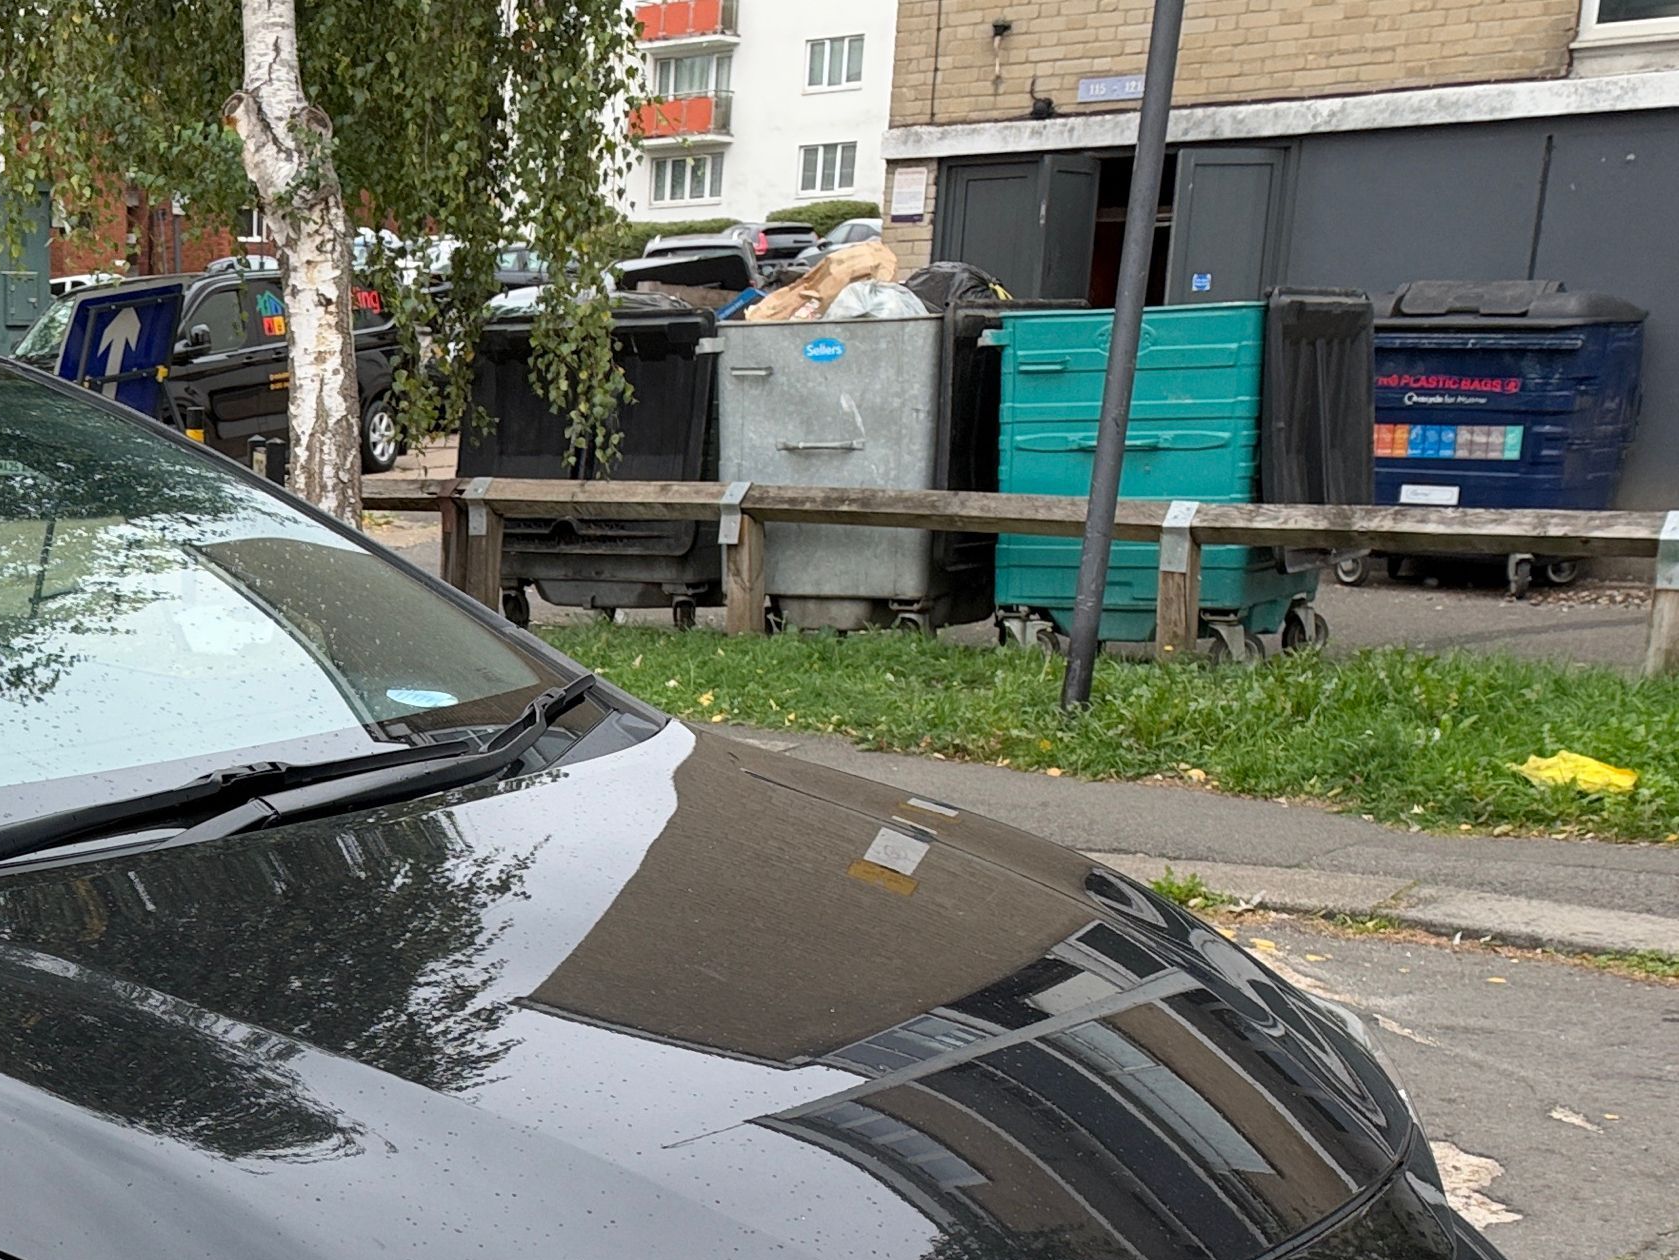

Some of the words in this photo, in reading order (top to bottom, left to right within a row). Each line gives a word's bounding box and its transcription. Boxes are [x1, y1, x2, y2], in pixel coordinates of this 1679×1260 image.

[806, 343, 843, 357] Sellers
[1400, 375, 1459, 389] PLASTIC
[1460, 378, 1502, 392] BAGS
